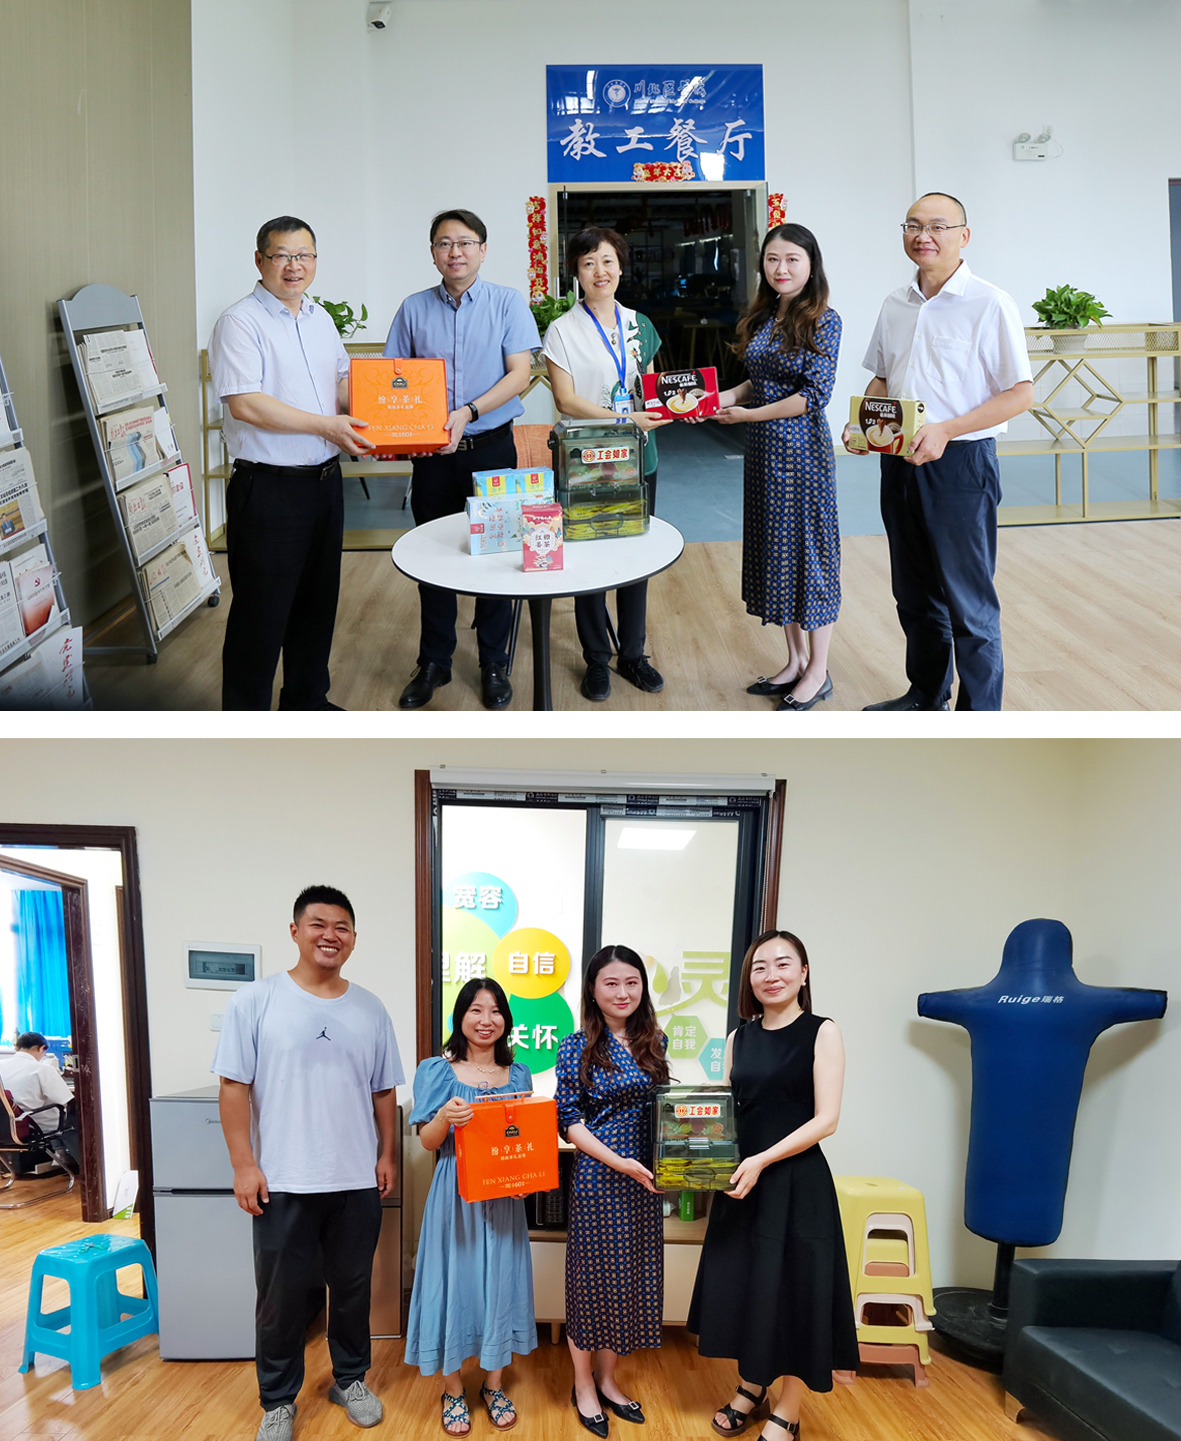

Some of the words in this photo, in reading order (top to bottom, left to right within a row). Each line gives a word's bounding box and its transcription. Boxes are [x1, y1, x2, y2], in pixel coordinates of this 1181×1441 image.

[560, 117, 753, 162] 教工餐厅
[596, 447, 630, 462] 工会如家
[454, 885, 503, 910] 宽容
[508, 951, 556, 975] 自信
[507, 1024, 558, 1050] 关怀
[672, 1025, 697, 1037] 肯定
[672, 1038, 696, 1050] 自我
[689, 1104, 721, 1117] 工会如家
[482, 1178, 496, 1186] FEN
[497, 1175, 520, 1184] XIANG
[522, 1172, 537, 1180] CHA
